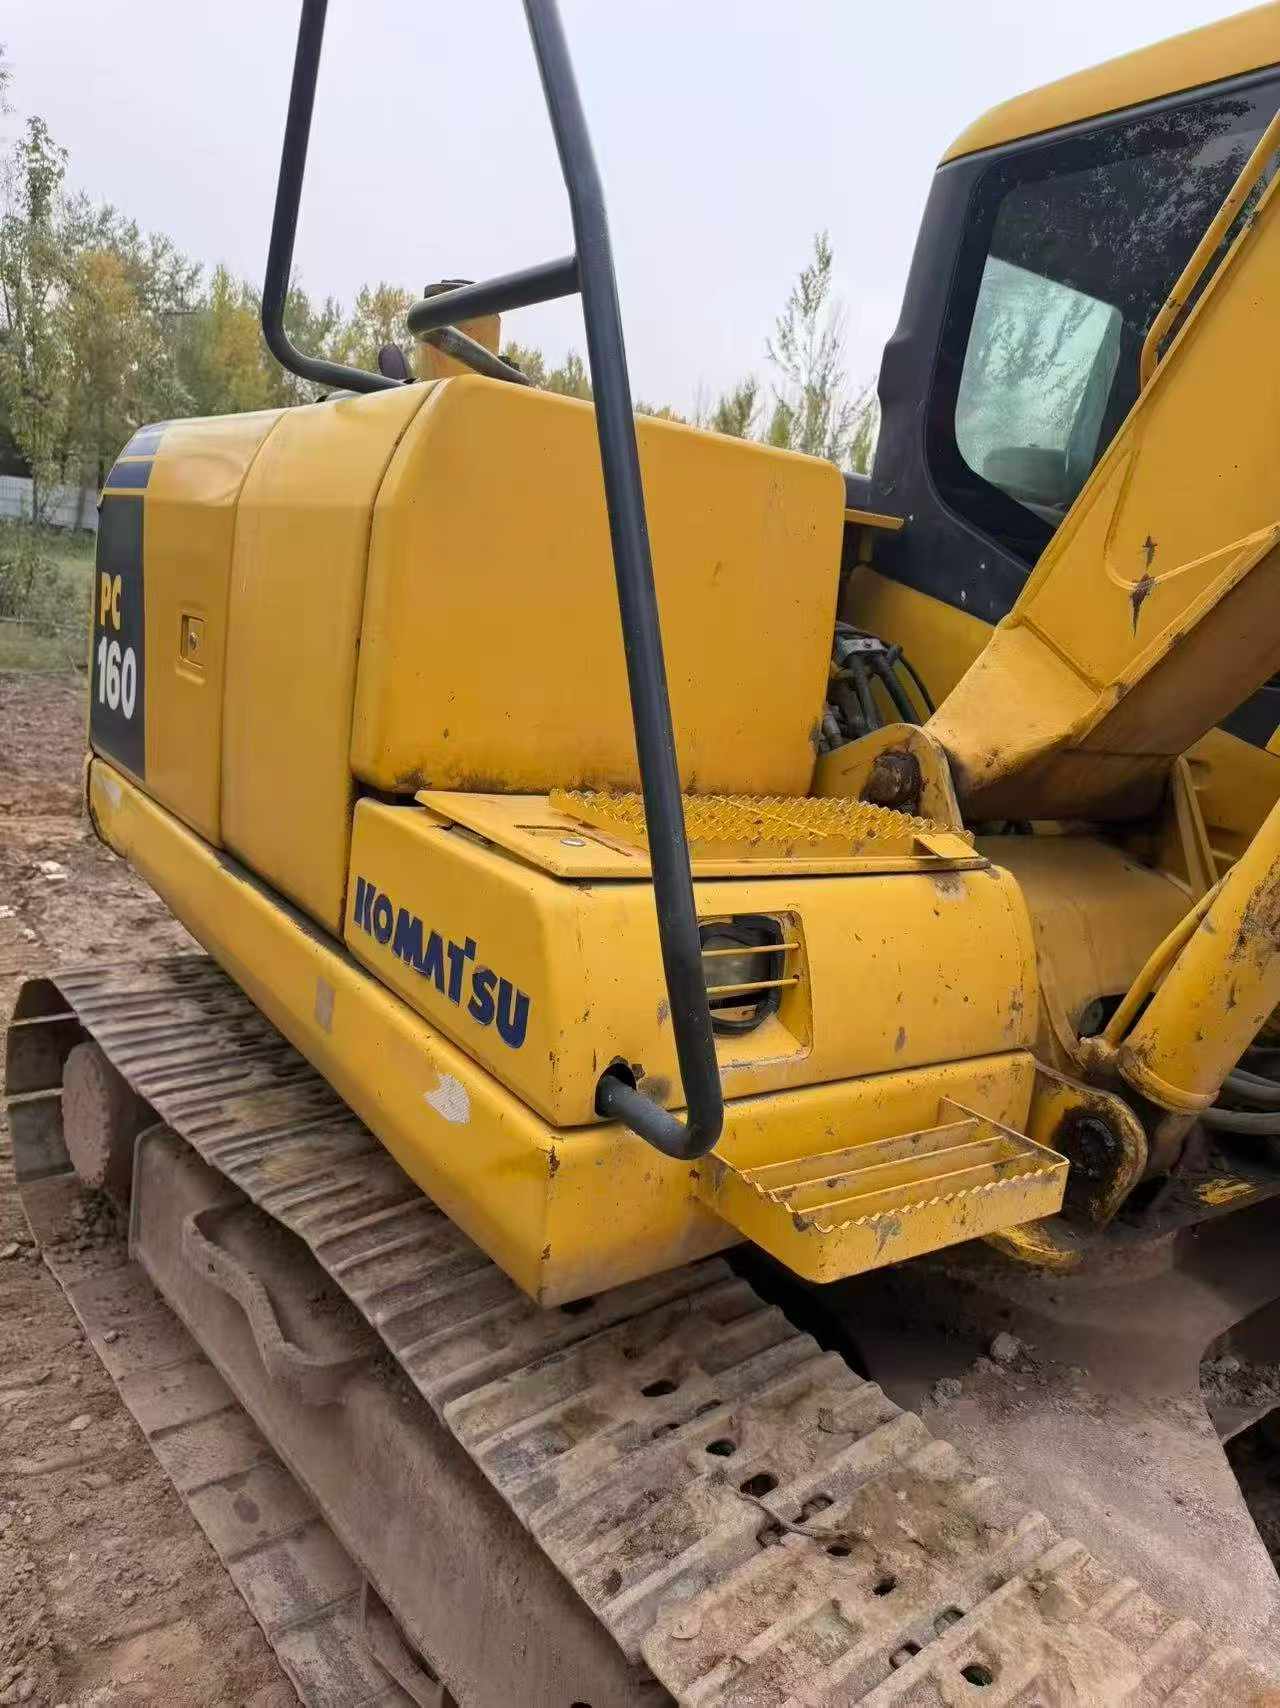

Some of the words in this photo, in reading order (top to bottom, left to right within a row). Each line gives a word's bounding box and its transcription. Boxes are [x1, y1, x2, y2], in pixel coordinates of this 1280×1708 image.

[100, 571, 122, 630] PC
[98, 636, 137, 720] 160
[353, 875, 531, 1049] KOMATSU
